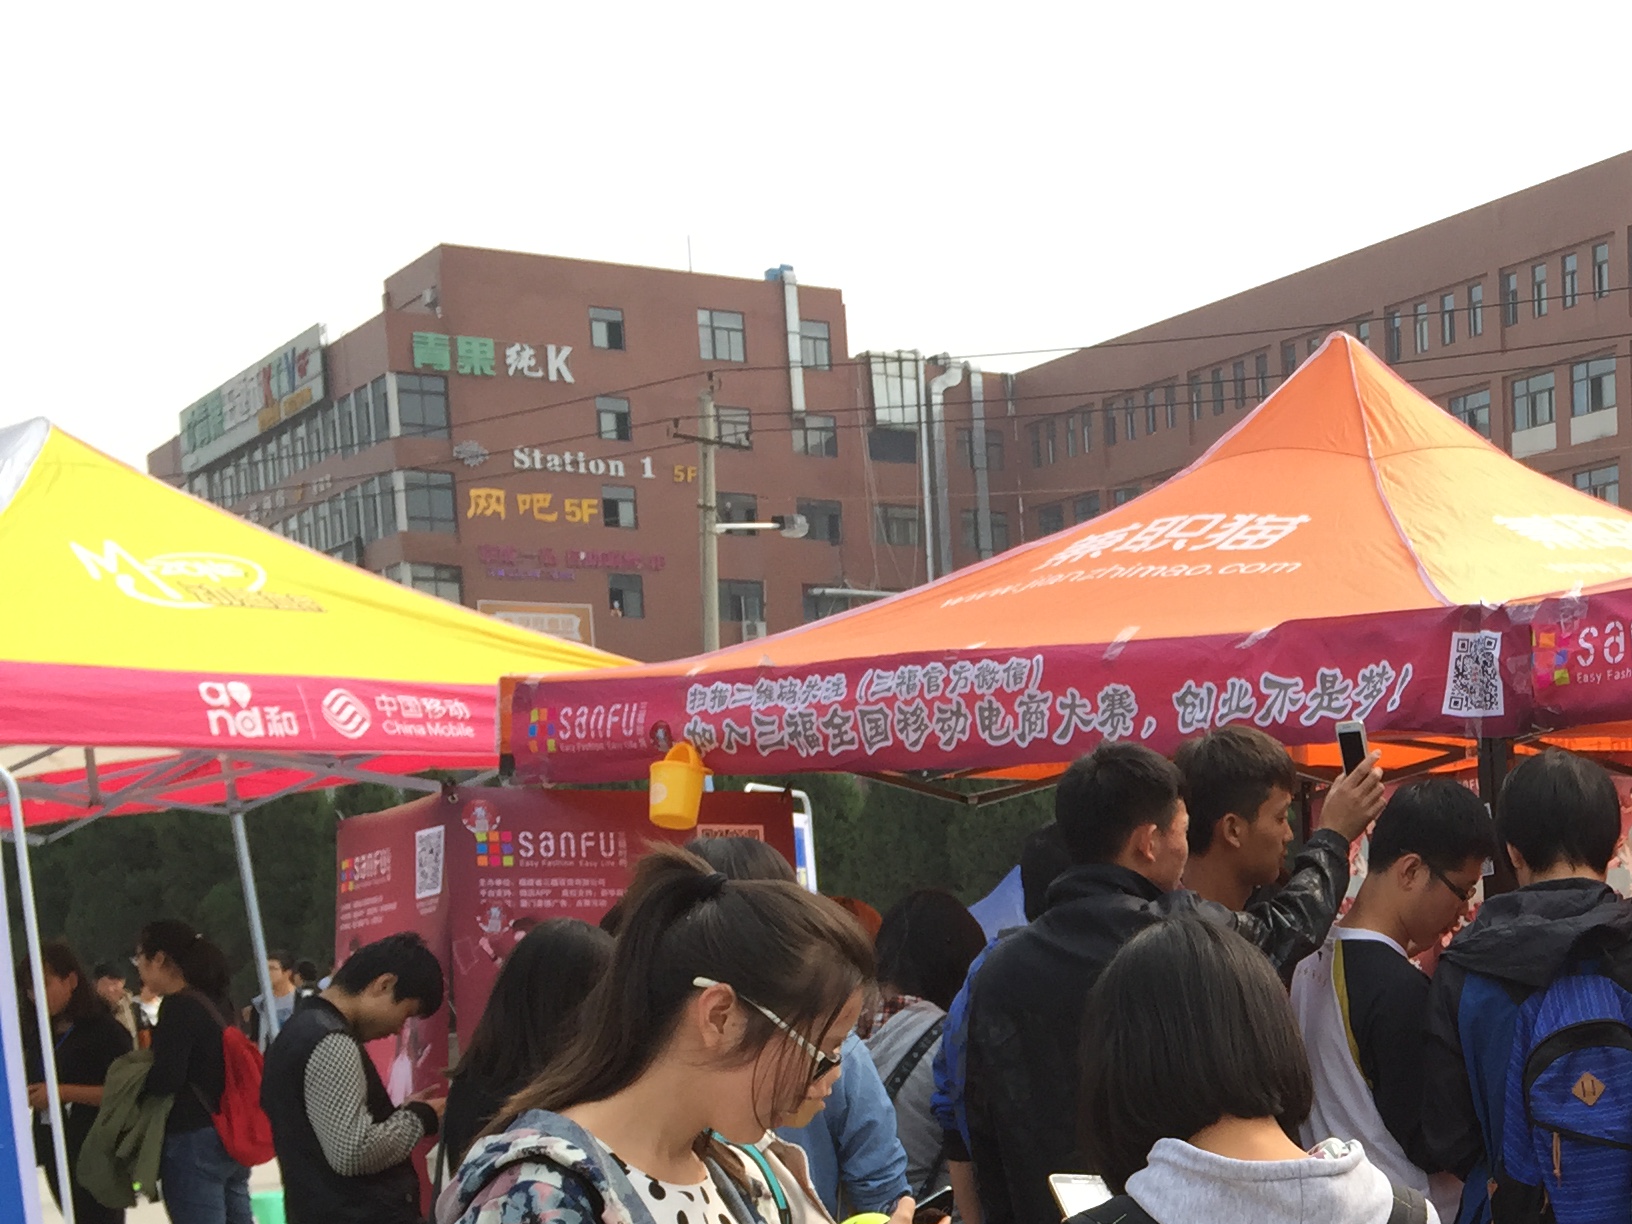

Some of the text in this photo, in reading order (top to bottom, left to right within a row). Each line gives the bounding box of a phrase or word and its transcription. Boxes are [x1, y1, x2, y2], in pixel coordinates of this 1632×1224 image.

[513, 447, 697, 483] Station 1 5F
[1032, 513, 1312, 572] 兼职猫
[940, 559, 1303, 609] www.jianzhimao.com
[1576, 671, 1602, 684] Easy
[374, 693, 472, 721] 中国移动
[382, 721, 477, 738] China Mobile
